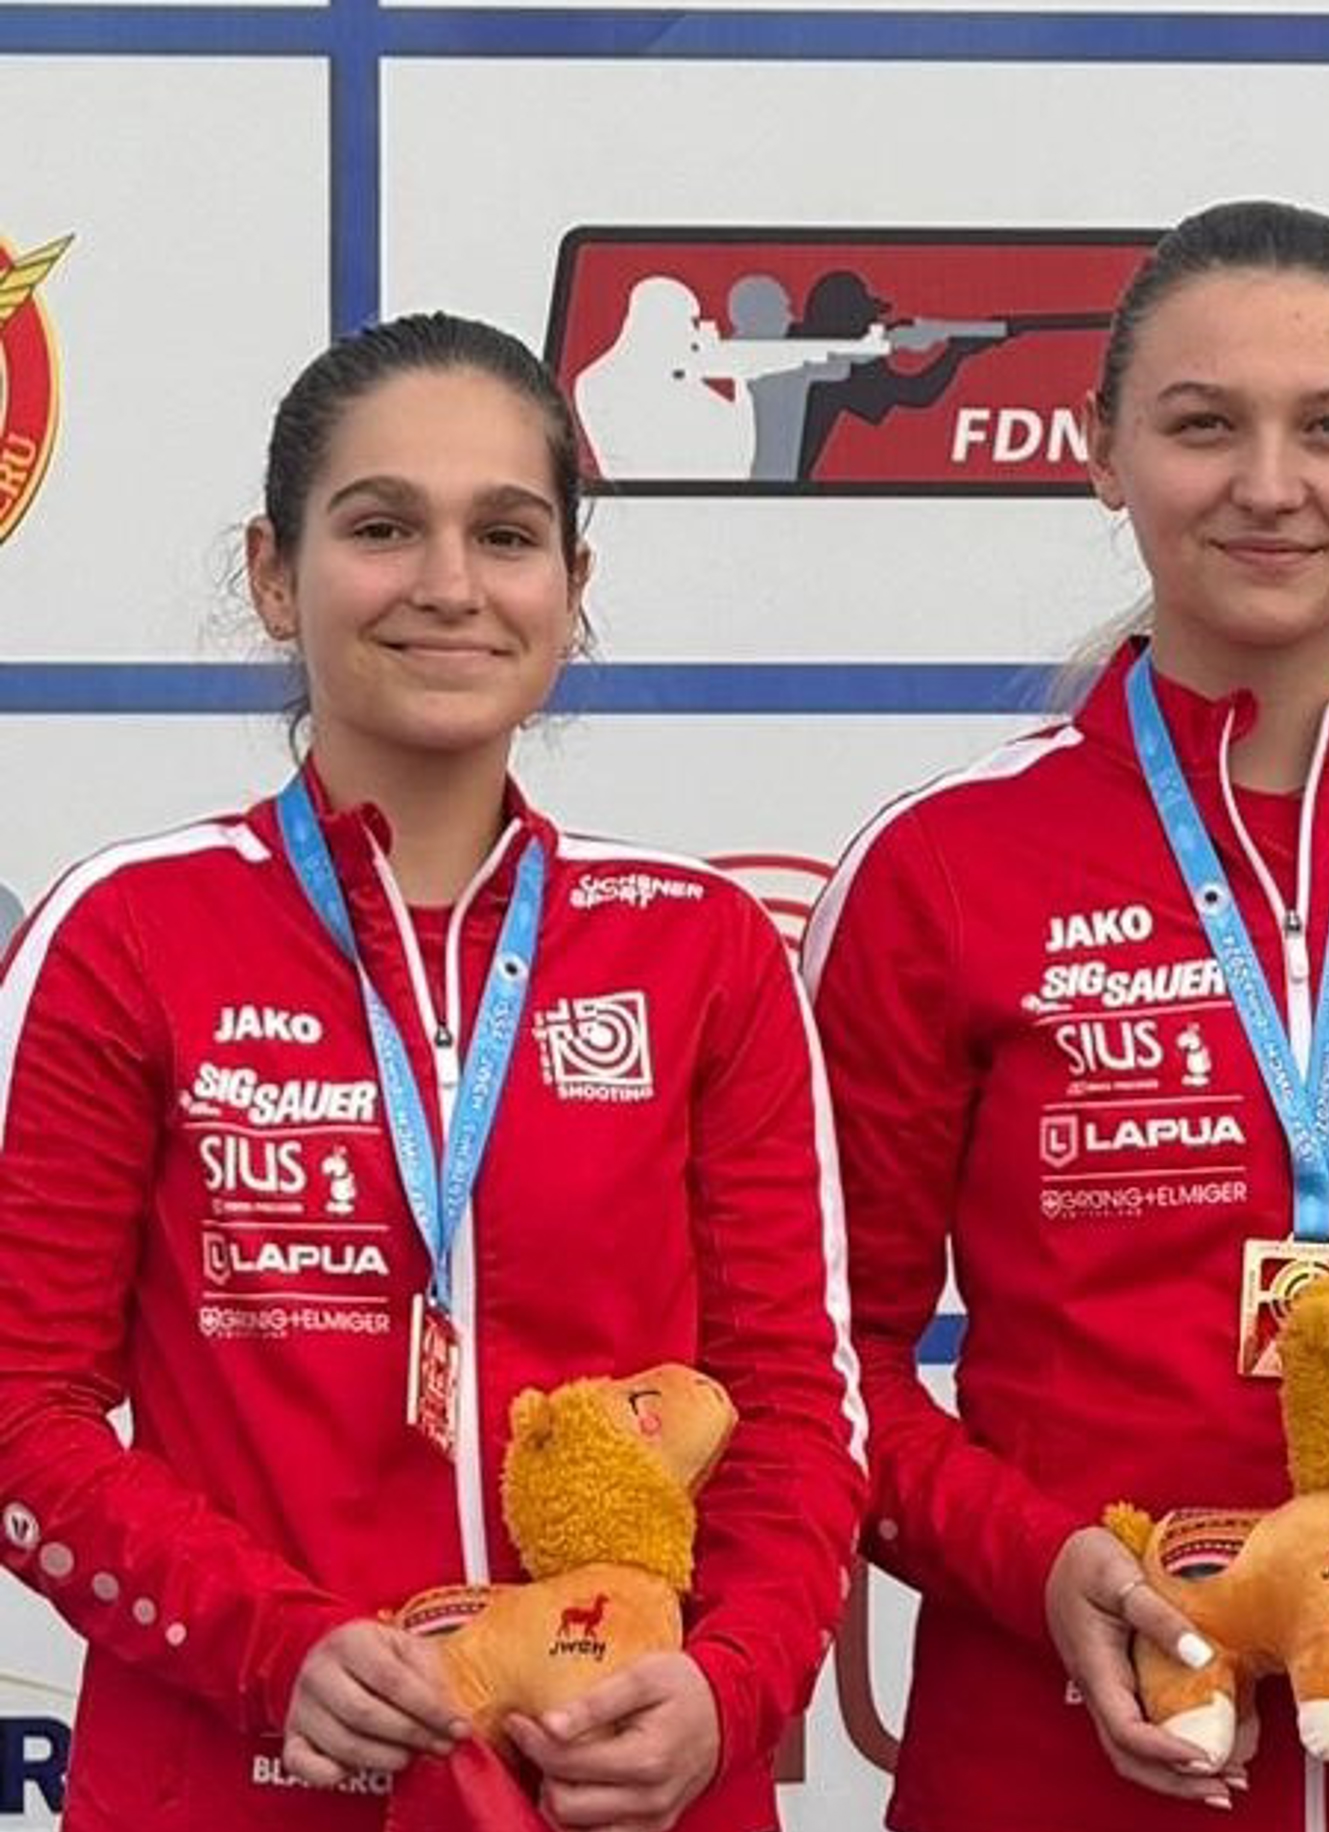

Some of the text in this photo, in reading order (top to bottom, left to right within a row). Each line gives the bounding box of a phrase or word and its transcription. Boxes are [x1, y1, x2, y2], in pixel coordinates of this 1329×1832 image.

[0, 432, 37, 514] RU
[1046, 905, 1152, 952] JAKO
[214, 1004, 324, 1044] JAKO
[1056, 1019, 1163, 1076] SIUS
[1085, 1115, 1246, 1151] LAPUA
[200, 1135, 306, 1193] SIUS
[230, 1243, 389, 1276] LAPUA
